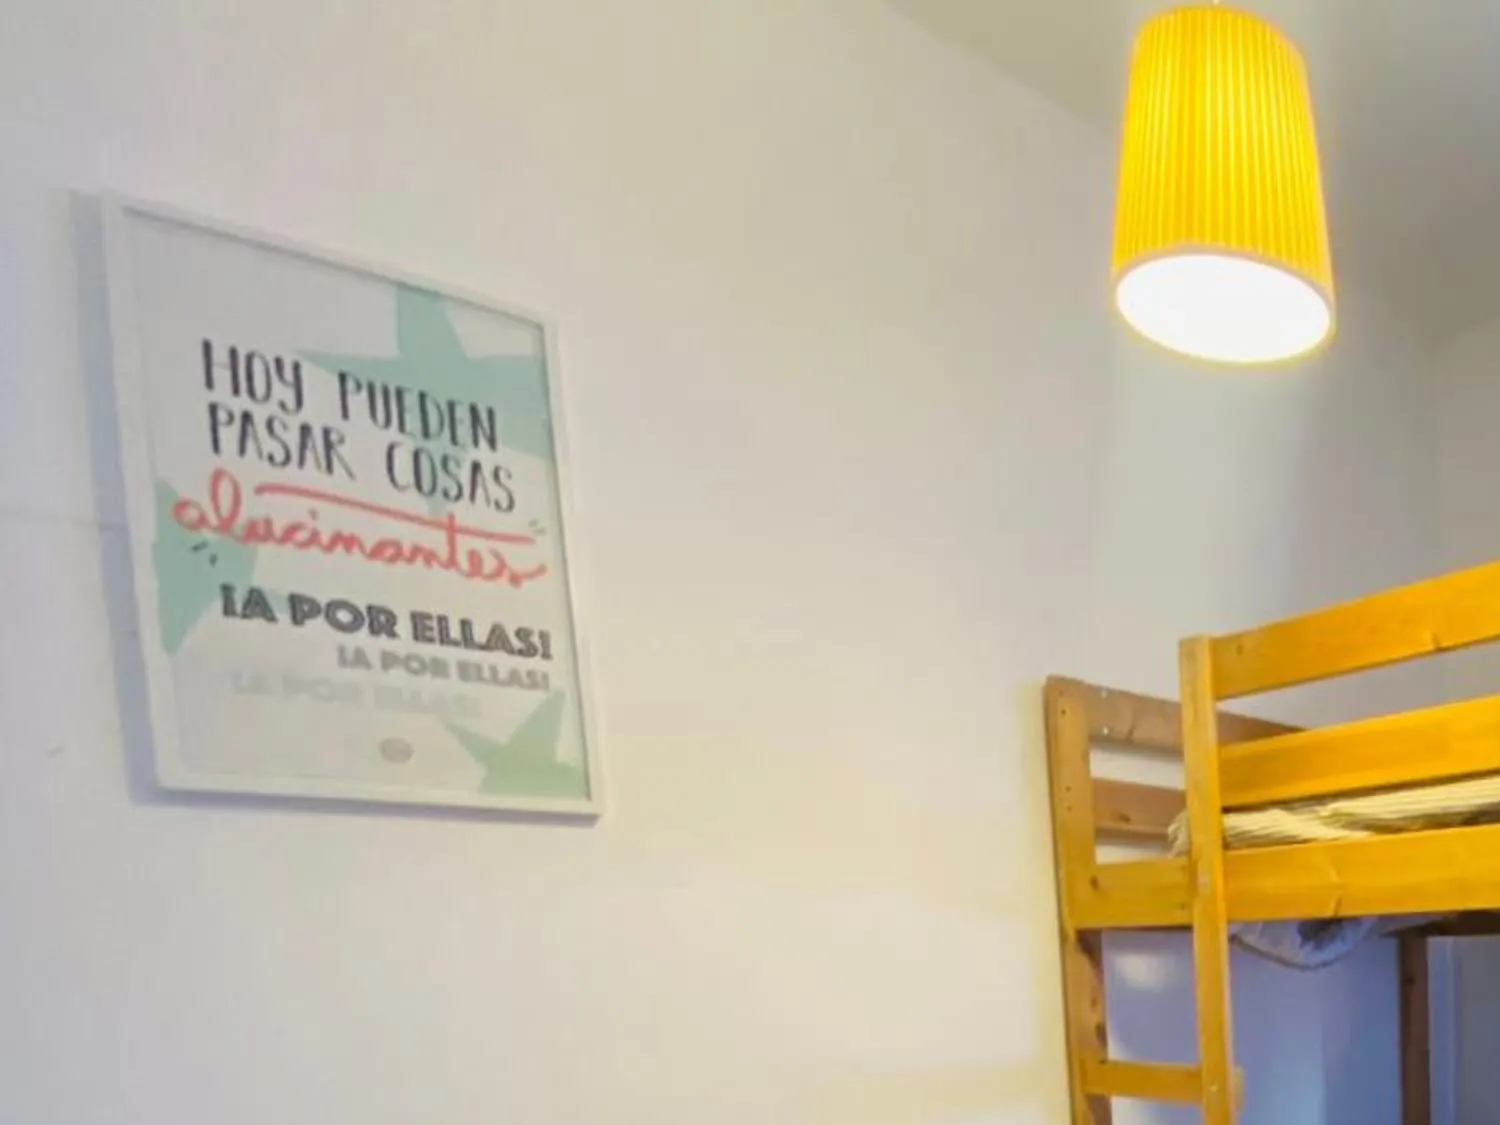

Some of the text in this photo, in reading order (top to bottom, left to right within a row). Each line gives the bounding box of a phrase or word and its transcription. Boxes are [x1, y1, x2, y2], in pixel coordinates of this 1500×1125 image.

[202, 338, 497, 452] HOY PUEDEN
[208, 402, 516, 513] PASAR COSAS
[170, 467, 548, 588] alucinantes
[288, 592, 401, 640] POR
[380, 648, 452, 682] POR
